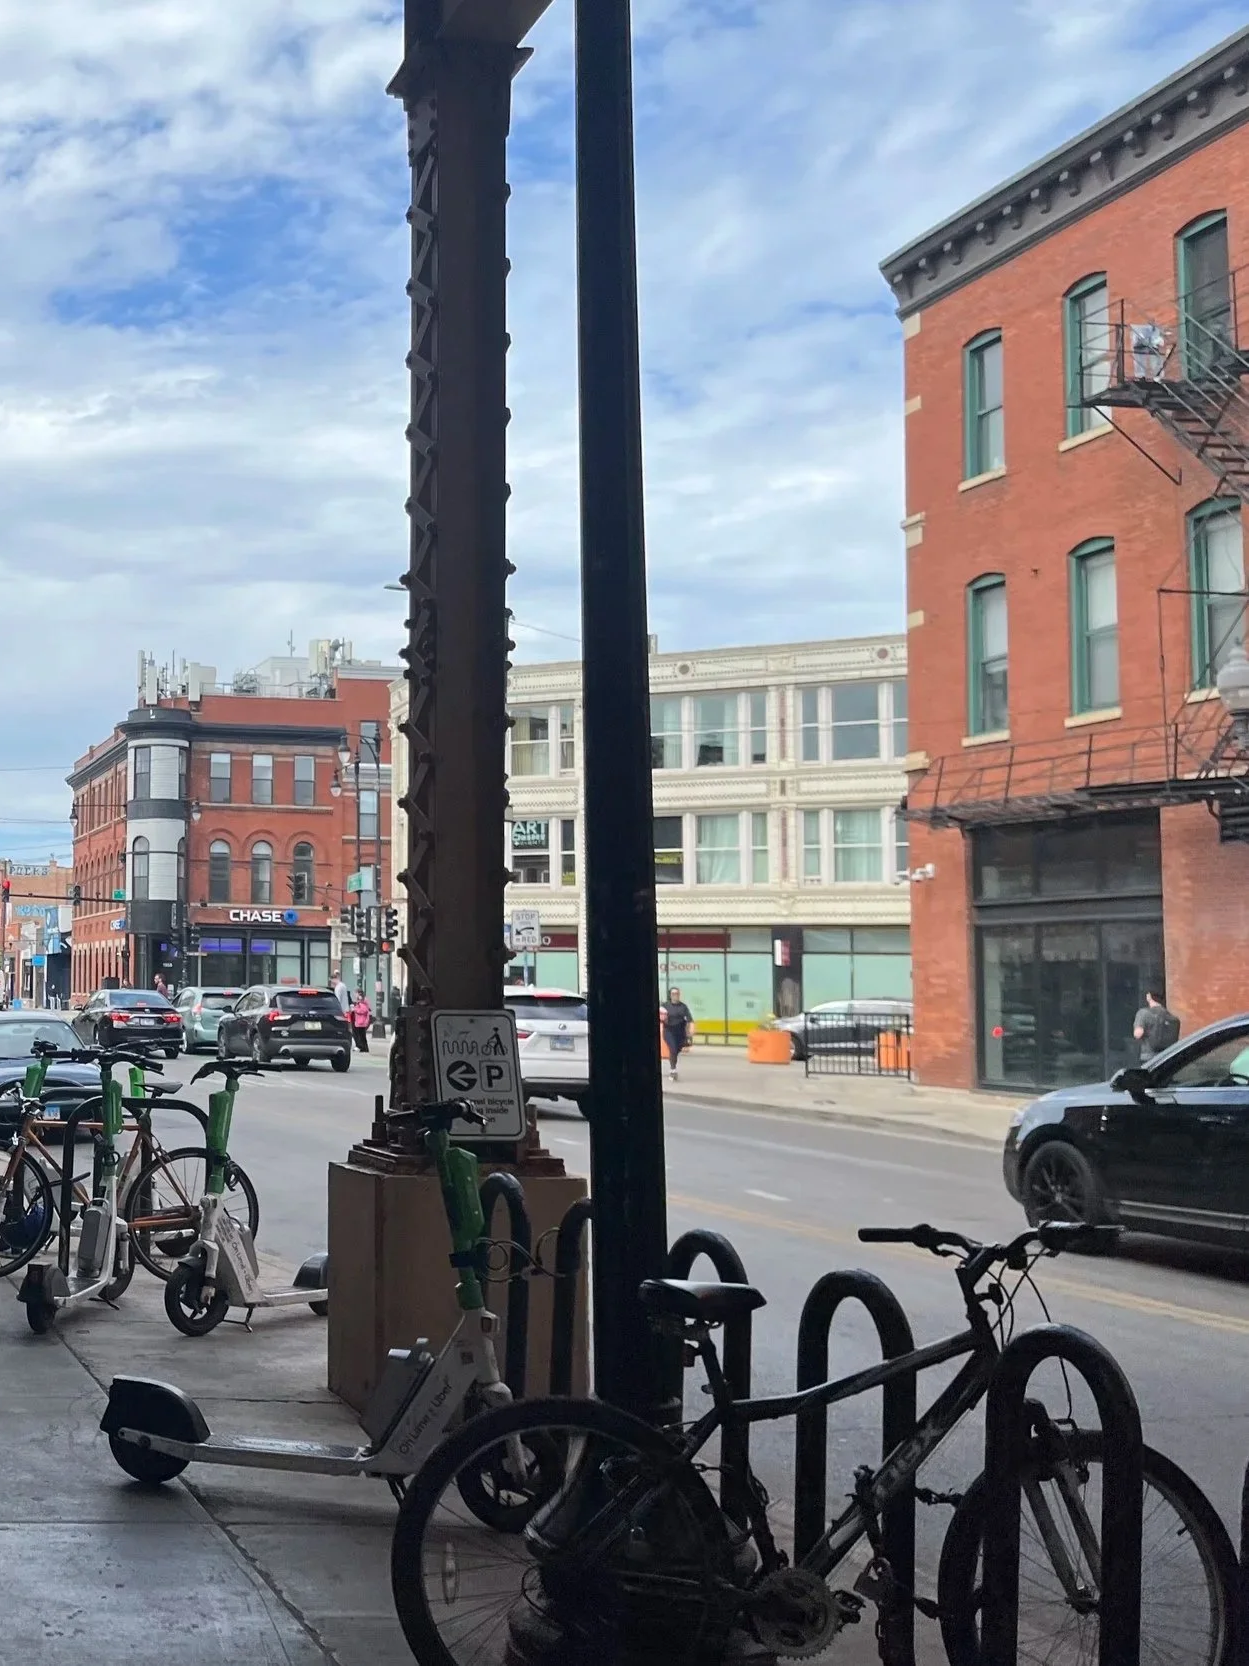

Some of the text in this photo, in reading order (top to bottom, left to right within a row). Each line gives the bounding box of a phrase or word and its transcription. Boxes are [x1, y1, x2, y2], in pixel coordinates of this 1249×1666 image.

[512, 821, 548, 834] ART
[229, 909, 282, 923] CHASE
[522, 935, 537, 944] RED
[668, 961, 701, 972] Soon
[485, 1065, 504, 1088] P
